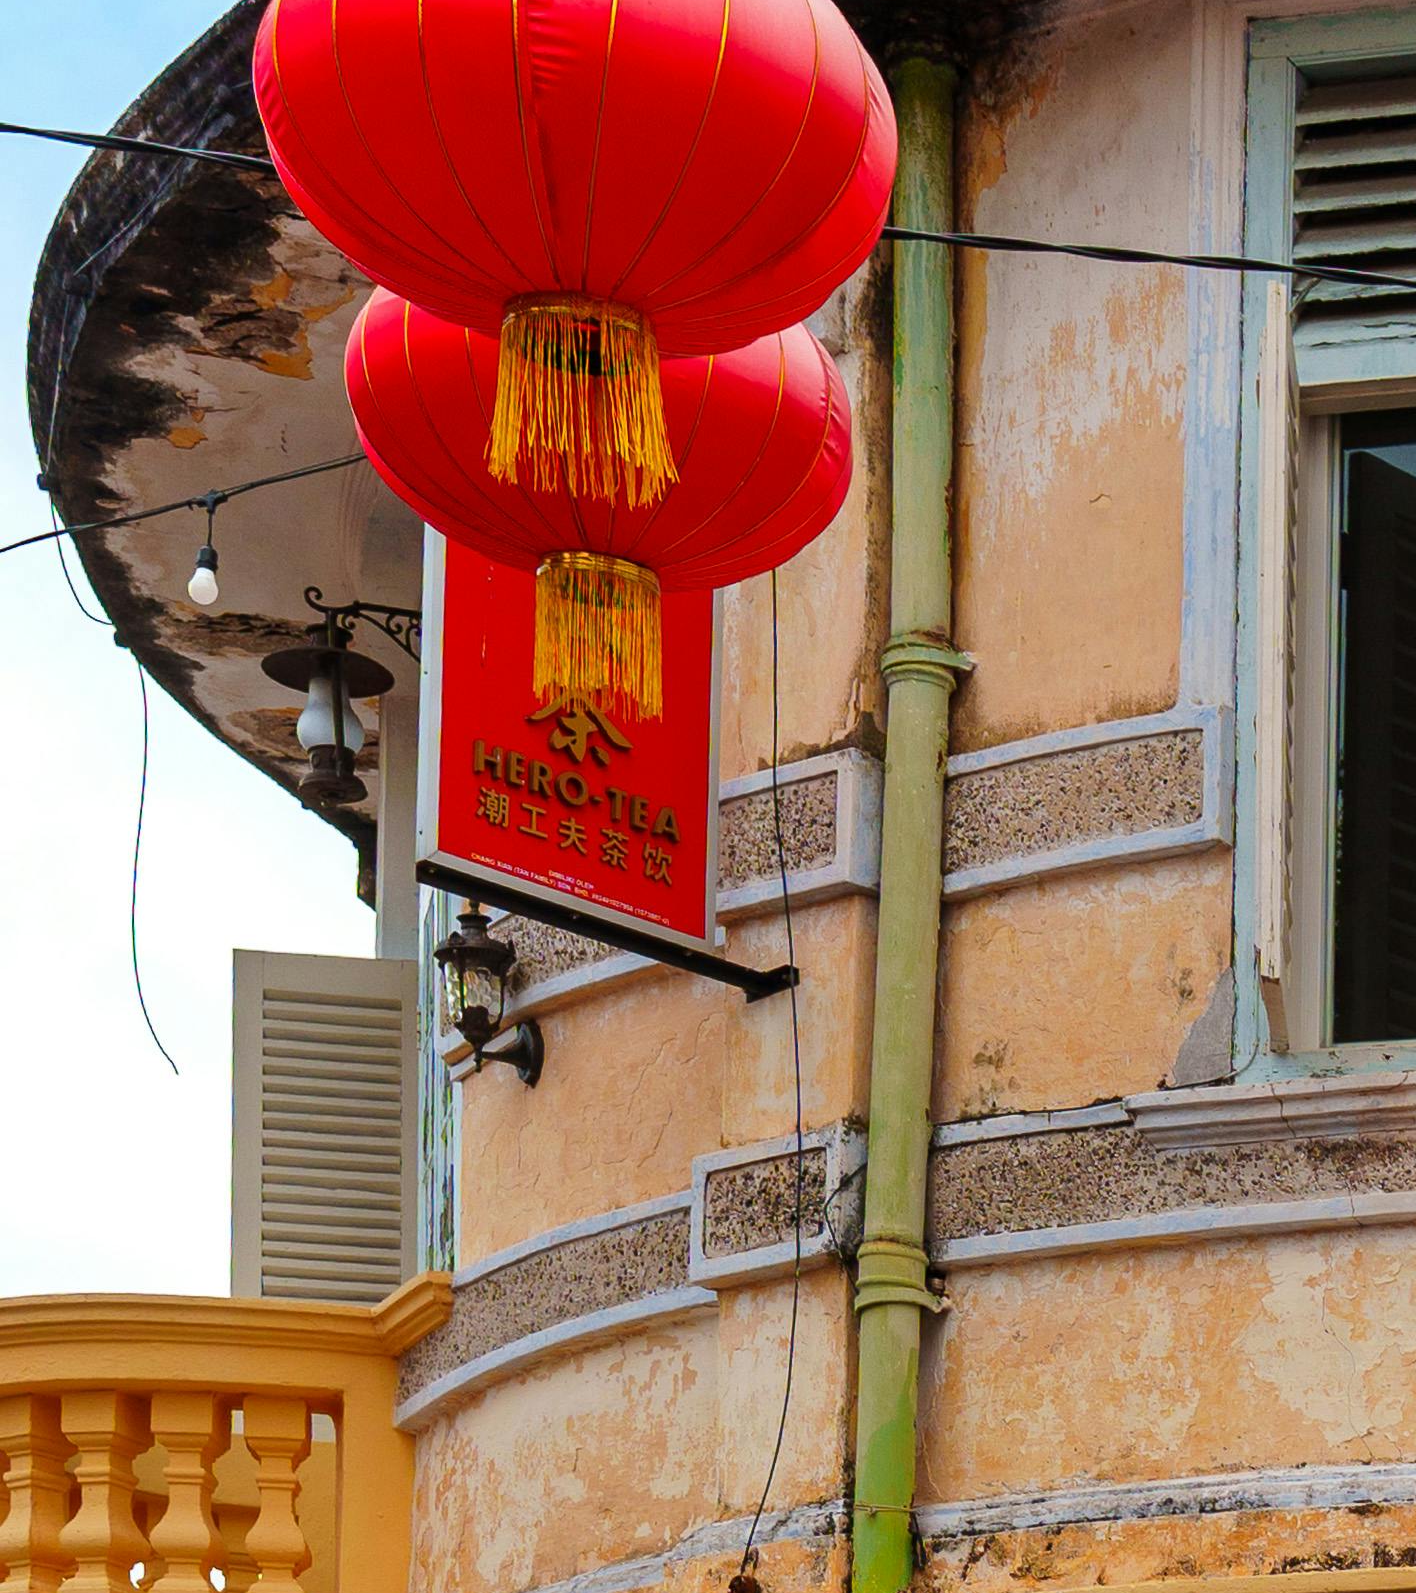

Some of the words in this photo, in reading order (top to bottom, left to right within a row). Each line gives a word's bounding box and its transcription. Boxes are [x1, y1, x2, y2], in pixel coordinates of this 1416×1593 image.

[474, 786, 674, 886] 潮工夫茶饮
